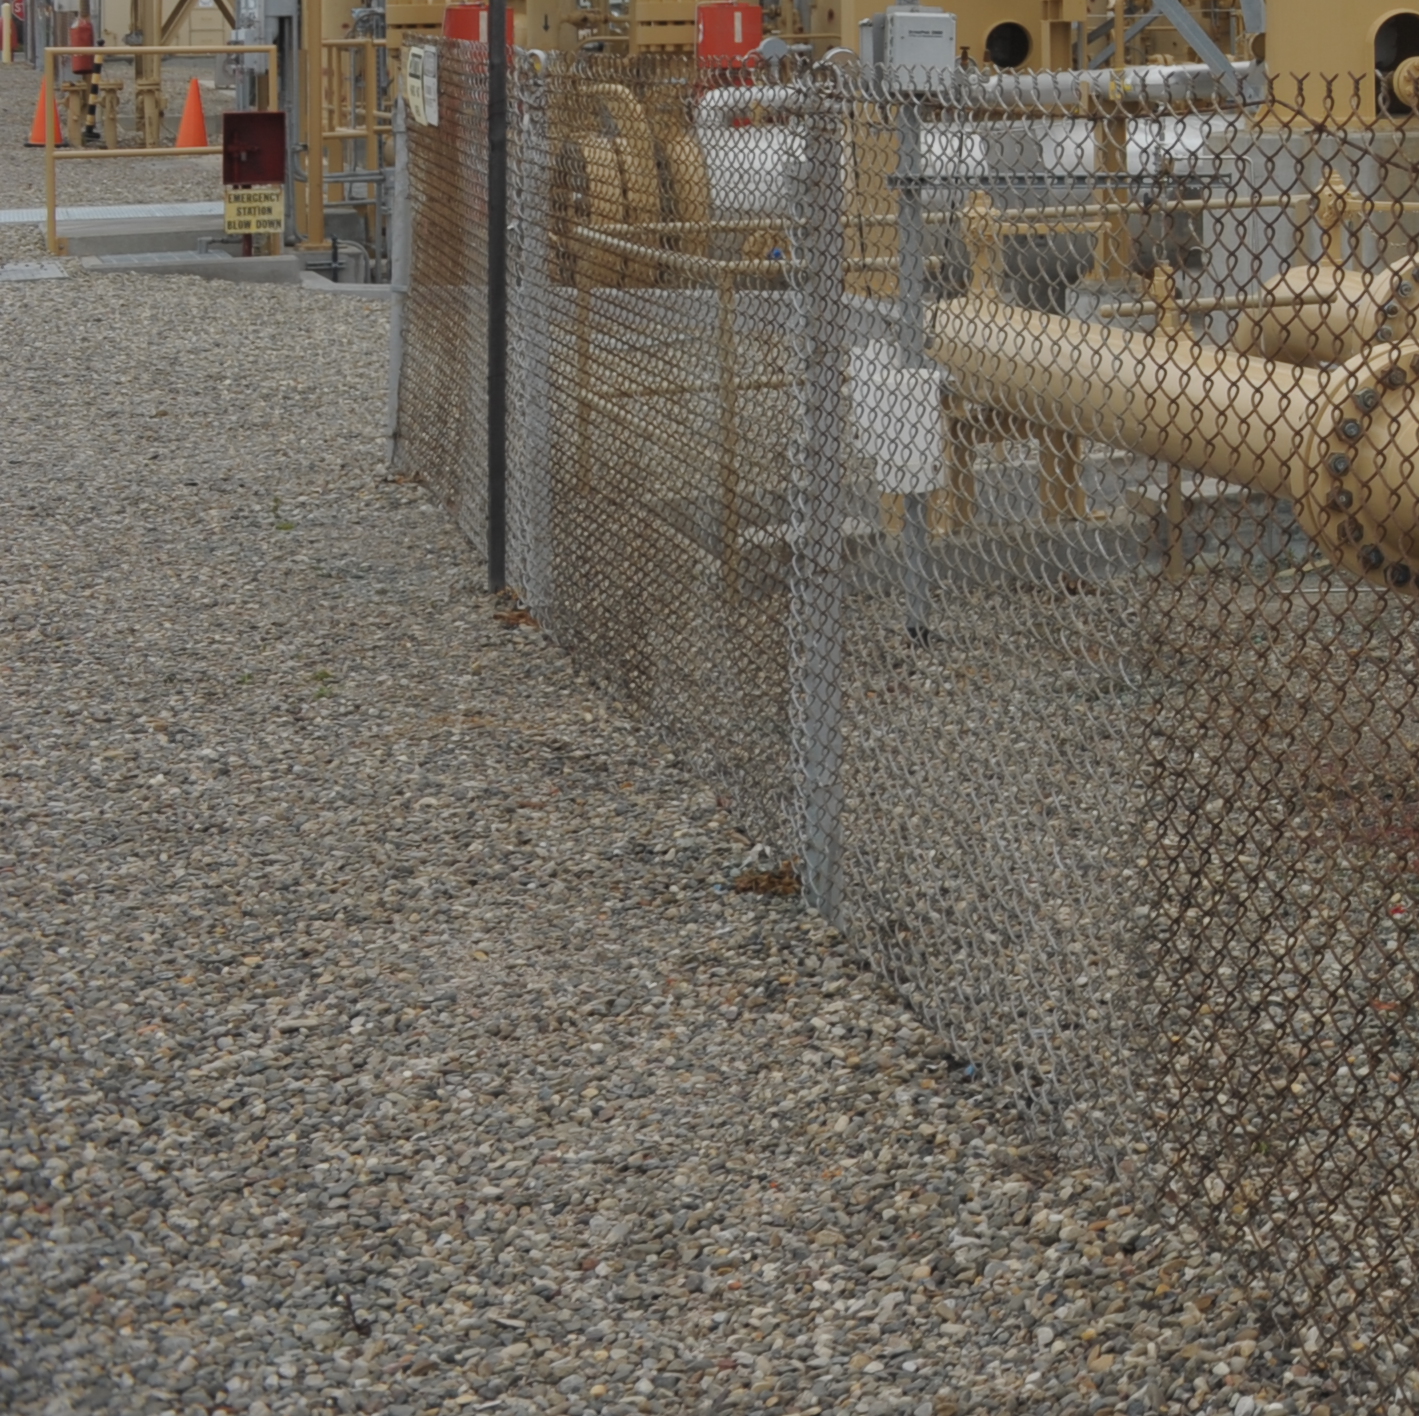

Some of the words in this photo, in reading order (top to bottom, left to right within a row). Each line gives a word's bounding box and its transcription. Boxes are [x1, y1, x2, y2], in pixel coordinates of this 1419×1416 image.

[227, 193, 280, 204] EMERGENCY
[236, 206, 273, 217] STATION
[227, 220, 252, 230] BLOW
[255, 219, 282, 229] DOWN
